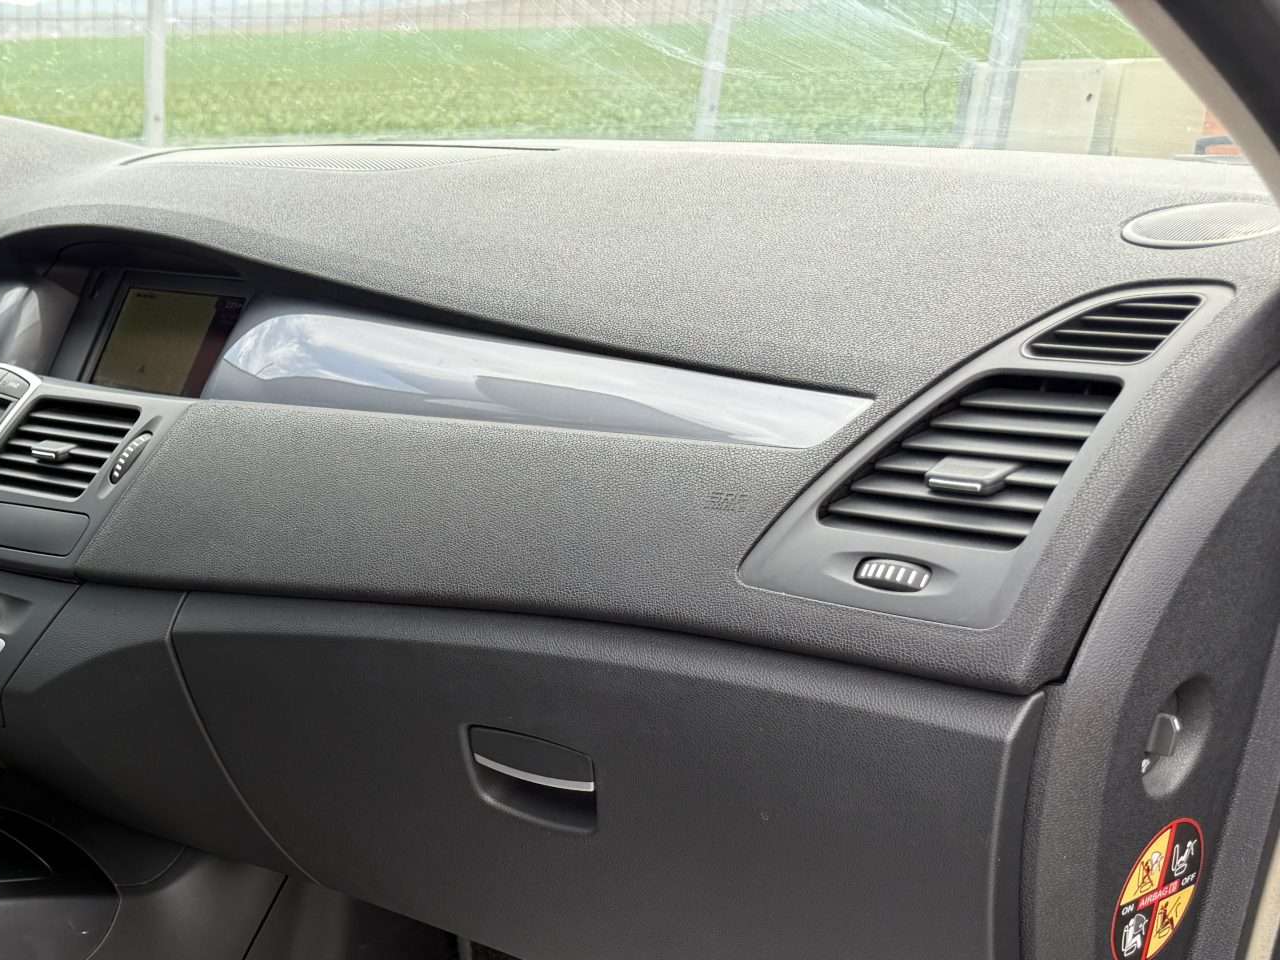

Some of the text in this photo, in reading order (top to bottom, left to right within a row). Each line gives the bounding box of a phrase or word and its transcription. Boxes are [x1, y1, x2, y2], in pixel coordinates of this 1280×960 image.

[1122, 872, 1196, 915] ON AIRBAG OFF
